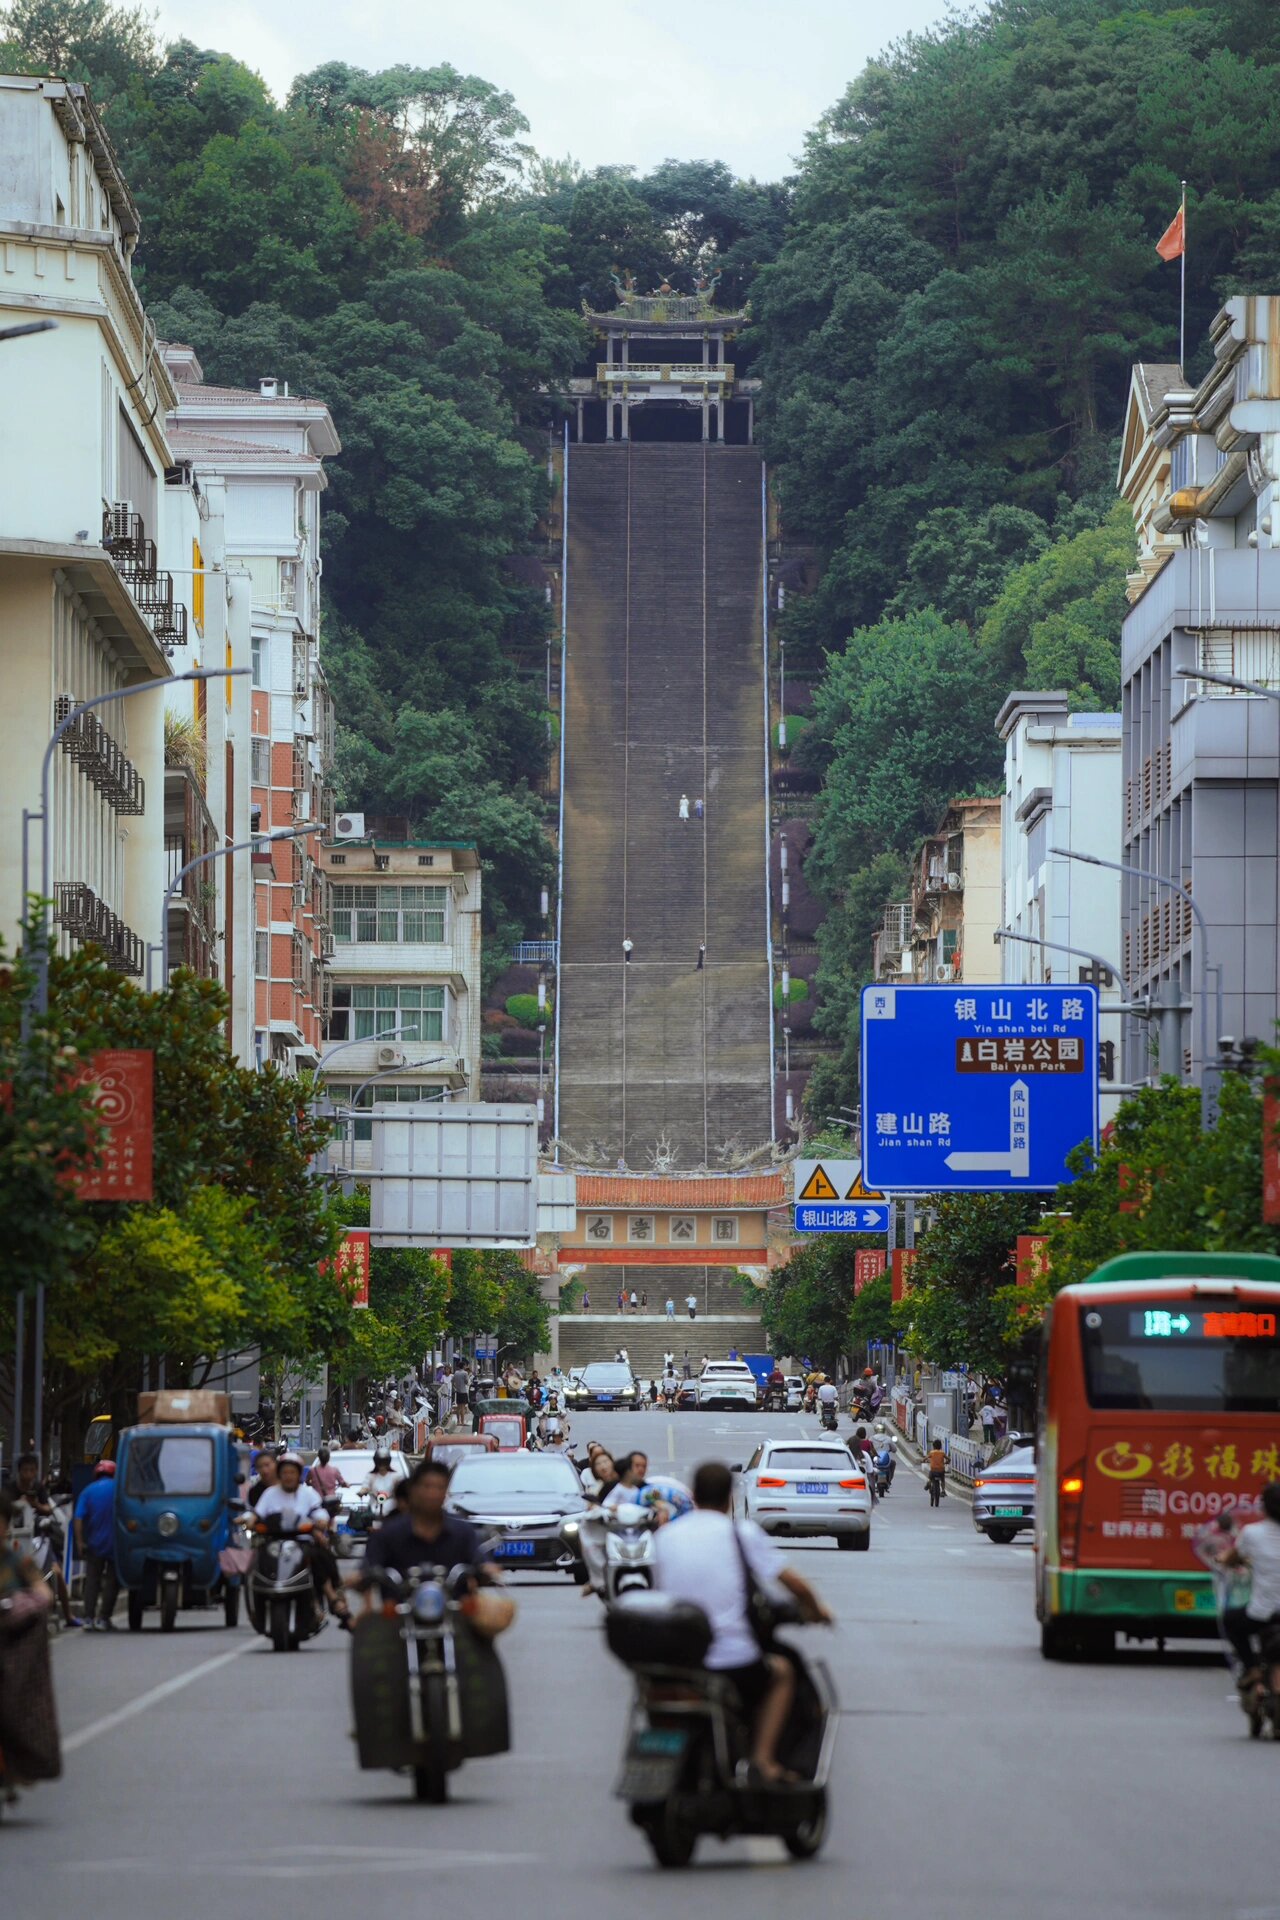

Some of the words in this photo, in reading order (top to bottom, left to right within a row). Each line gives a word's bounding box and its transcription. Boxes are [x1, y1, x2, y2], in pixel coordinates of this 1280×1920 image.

[875, 997, 886, 1008] 西
[954, 998, 1085, 1021] 银山北路
[974, 1024, 992, 1033] Yin
[998, 1024, 1025, 1033] shan
[1031, 1024, 1047, 1033] bei
[1053, 1024, 1067, 1033] Rd
[978, 1038, 1079, 1062] 白岩公园
[991, 1062, 1009, 1071] Bai
[1014, 1064, 1035, 1073] yan
[1040, 1062, 1066, 1071] Park
[875, 1112, 951, 1135] 建山路
[1012, 1089, 1026, 1150] 凤山西路
[878, 1138, 901, 1147] Jian
[906, 1138, 933, 1147] shan
[938, 1138, 951, 1147] Rd
[802, 1209, 857, 1227] 银山北路
